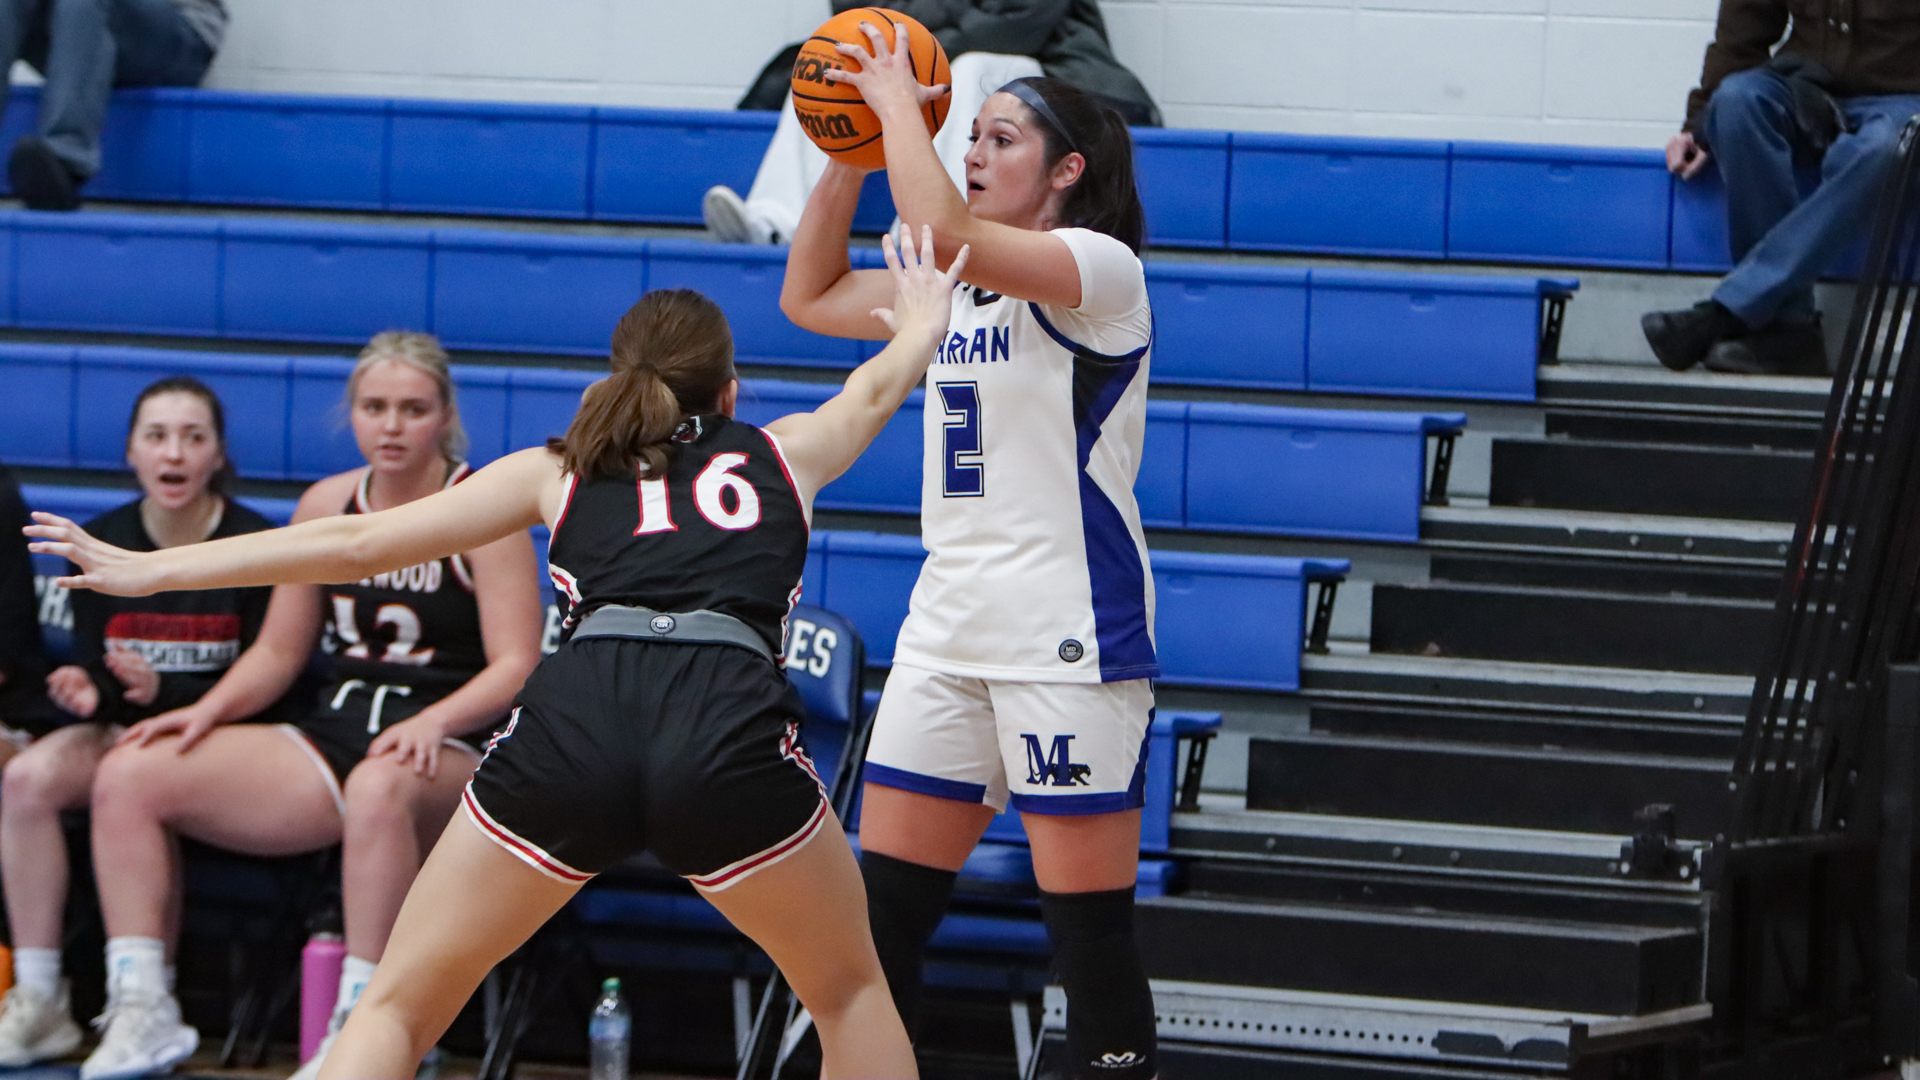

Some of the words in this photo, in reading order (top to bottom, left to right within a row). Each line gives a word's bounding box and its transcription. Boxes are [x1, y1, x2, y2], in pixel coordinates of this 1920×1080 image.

[931, 325, 1010, 365] ARIAN
[936, 381, 984, 498] 2
[633, 452, 762, 537] 16
[331, 594, 436, 667] 12
[785, 618, 838, 679] ES
